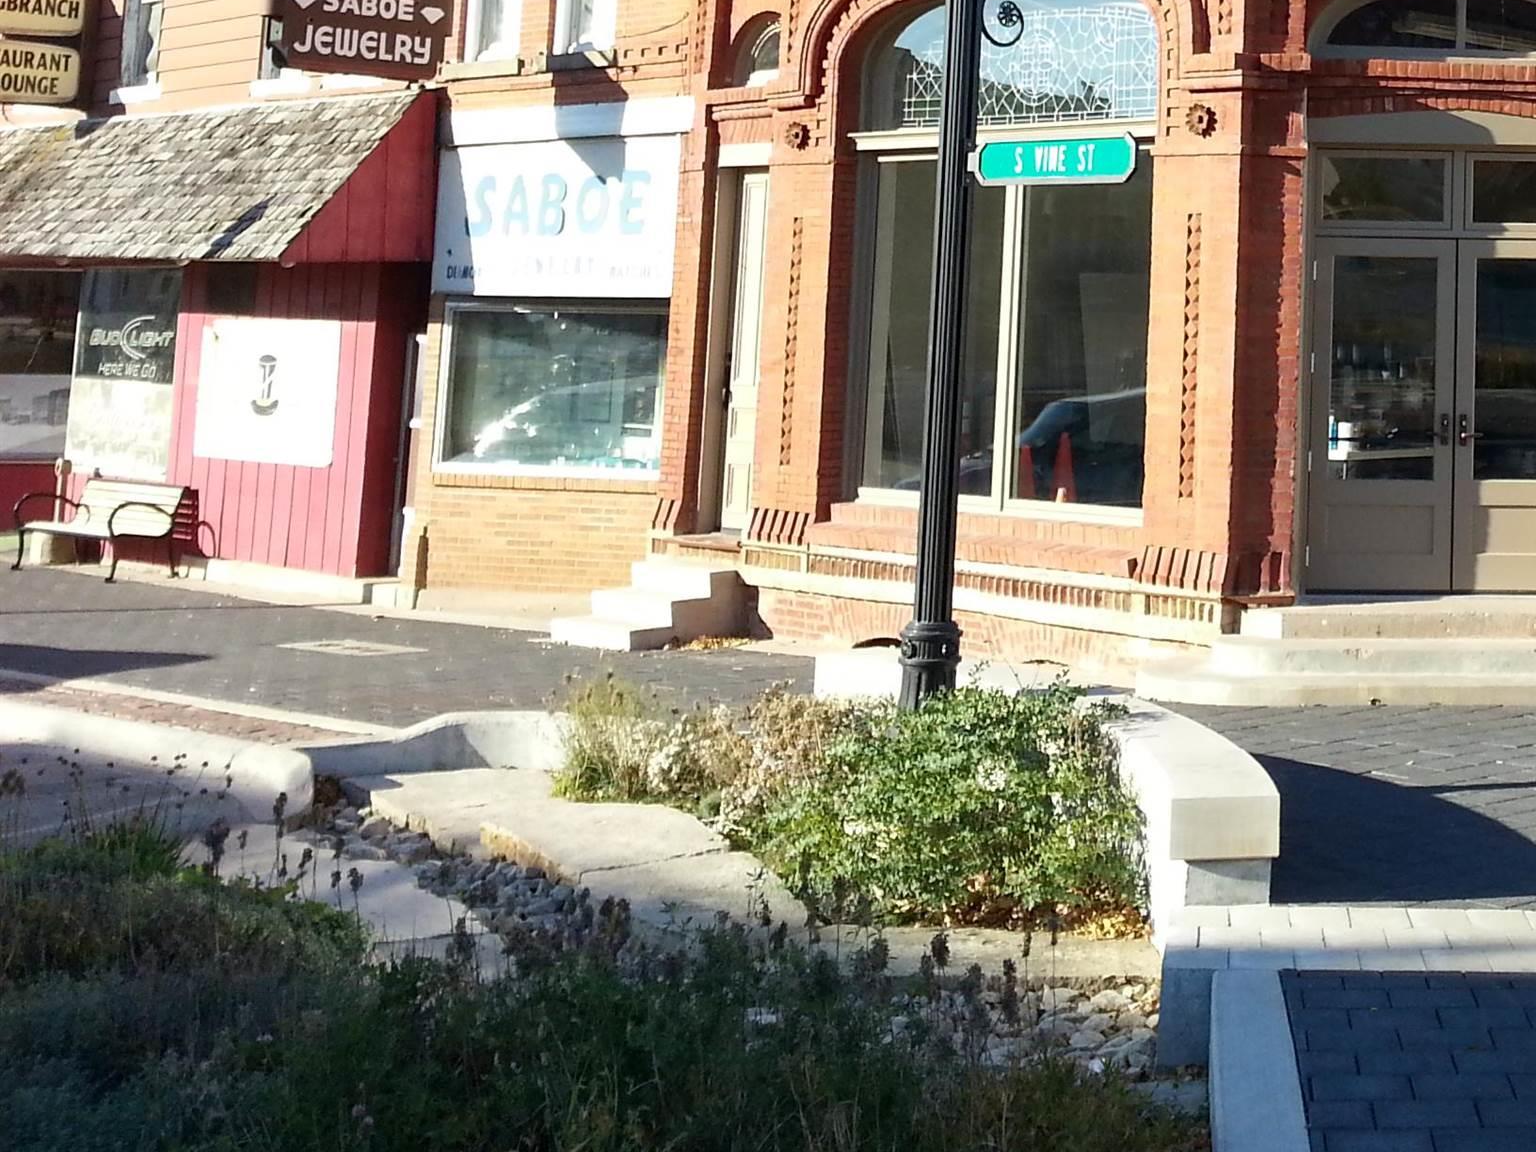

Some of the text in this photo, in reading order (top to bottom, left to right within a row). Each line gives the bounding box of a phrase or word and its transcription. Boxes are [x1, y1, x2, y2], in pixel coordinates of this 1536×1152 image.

[293, 24, 431, 65] JEWELRY
[1, 73, 59, 95] OUNGE
[1014, 143, 1096, 174] S VINE ST
[465, 169, 651, 238] SABOE
[129, 330, 175, 347] LIGHT
[97, 361, 157, 379] HERE WE GO
